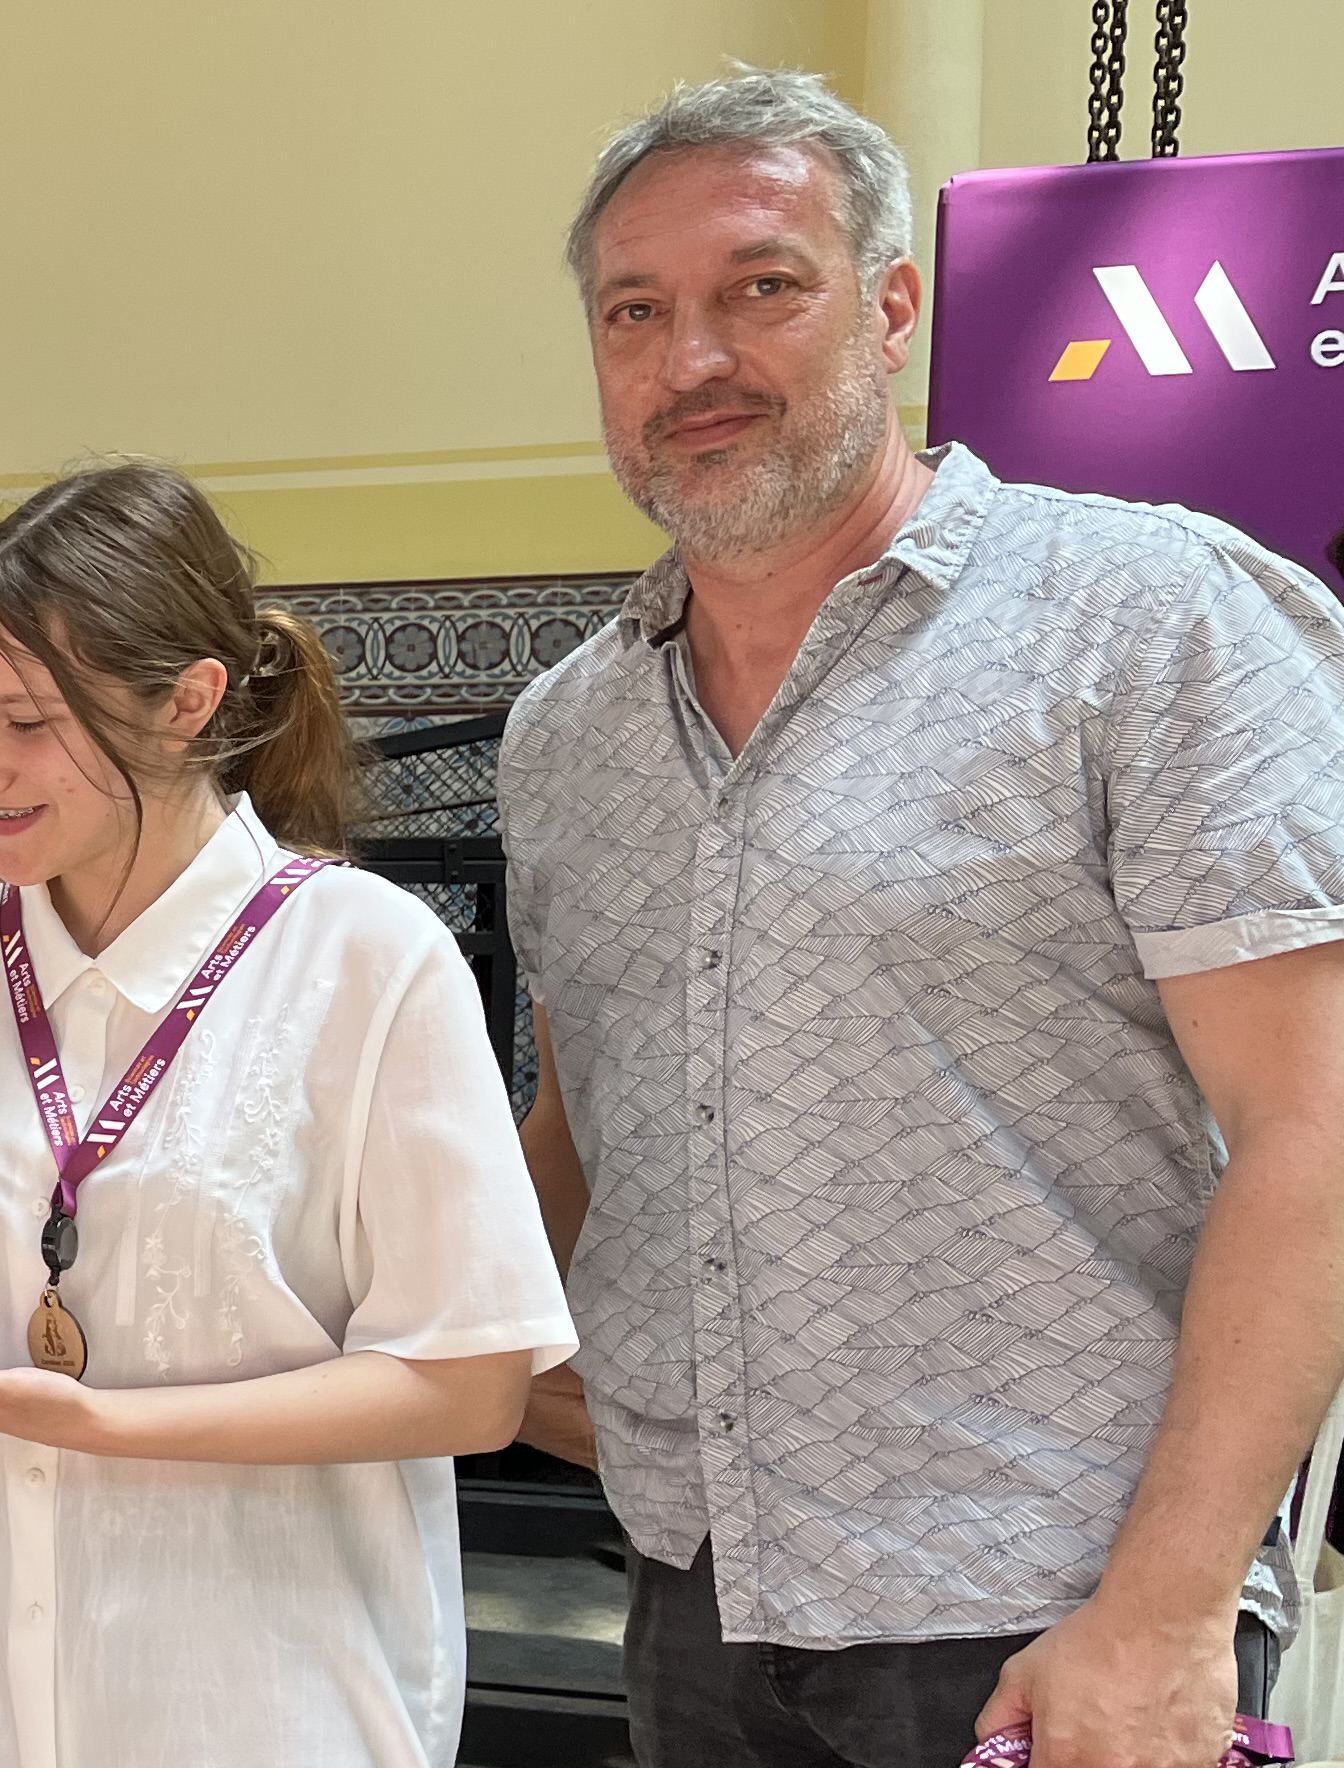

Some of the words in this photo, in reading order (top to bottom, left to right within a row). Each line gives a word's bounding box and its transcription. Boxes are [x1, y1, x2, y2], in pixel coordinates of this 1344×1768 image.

[19, 963, 32, 987] Arts
[201, 954, 223, 979] Arts
[52, 1091, 68, 1115] Arts
[109, 1085, 132, 1112] Arts
